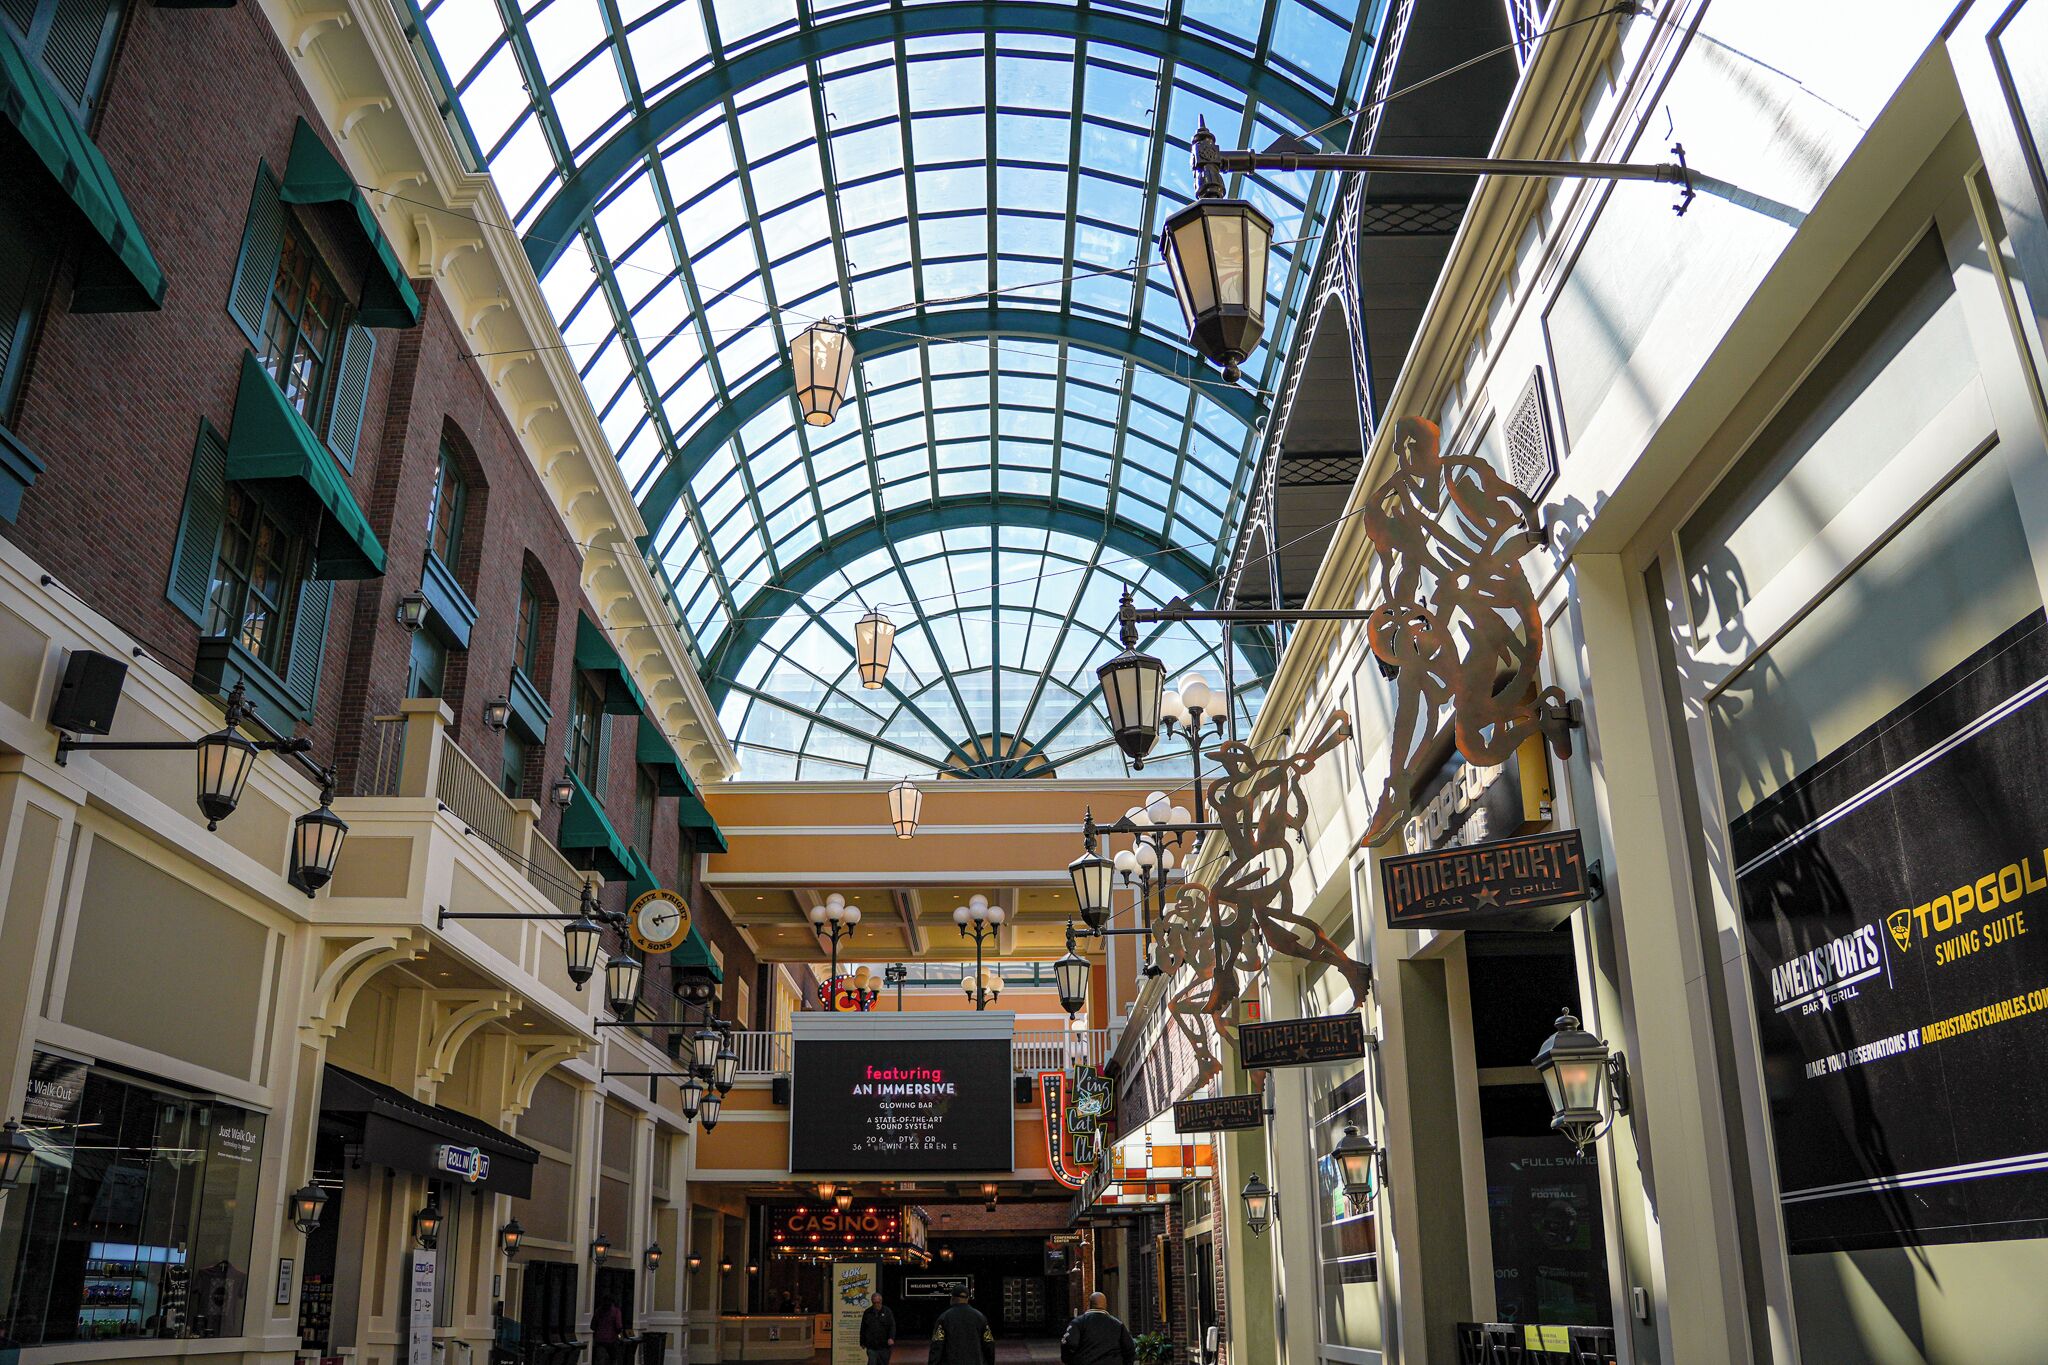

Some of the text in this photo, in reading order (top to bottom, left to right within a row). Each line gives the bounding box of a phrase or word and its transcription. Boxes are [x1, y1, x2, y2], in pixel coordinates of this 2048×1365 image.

[1392, 840, 1581, 913] AMERISPORTS
[632, 891, 687, 920] FRITZ WRIGHT
[1425, 881, 1563, 908] BAR GRILL
[1913, 848, 2048, 938] TOPGOL
[647, 941, 672, 950] SONS
[1935, 911, 2026, 966] SWING SUITE
[1771, 924, 1879, 1005] AMERISPORTS
[1802, 985, 1859, 1015] BAR GRILL
[1245, 1019, 1361, 1063] AMERISPORTS
[1805, 1060, 1826, 1079] MAKE
[1826, 1052, 1847, 1073] YOUR
[1848, 1033, 1906, 1066] RESERVATIONS
[1908, 1029, 1920, 1049] AT
[866, 1065, 941, 1082] featuring
[34, 1079, 55, 1096] Walk
[56, 1085, 72, 1100] Out
[852, 1083, 954, 1095] AN IMMERSIVE
[1076, 1066, 1110, 1111] King
[1069, 1108, 1093, 1132] Cat
[218, 1125, 256, 1144] Just Walk Out
[448, 1151, 462, 1168] ROLL
[462, 1155, 470, 1169] IN
[1521, 1157, 1554, 1166] FULL
[1531, 1191, 1577, 1199] FOOTBALL
[788, 1215, 879, 1231] CASINO
